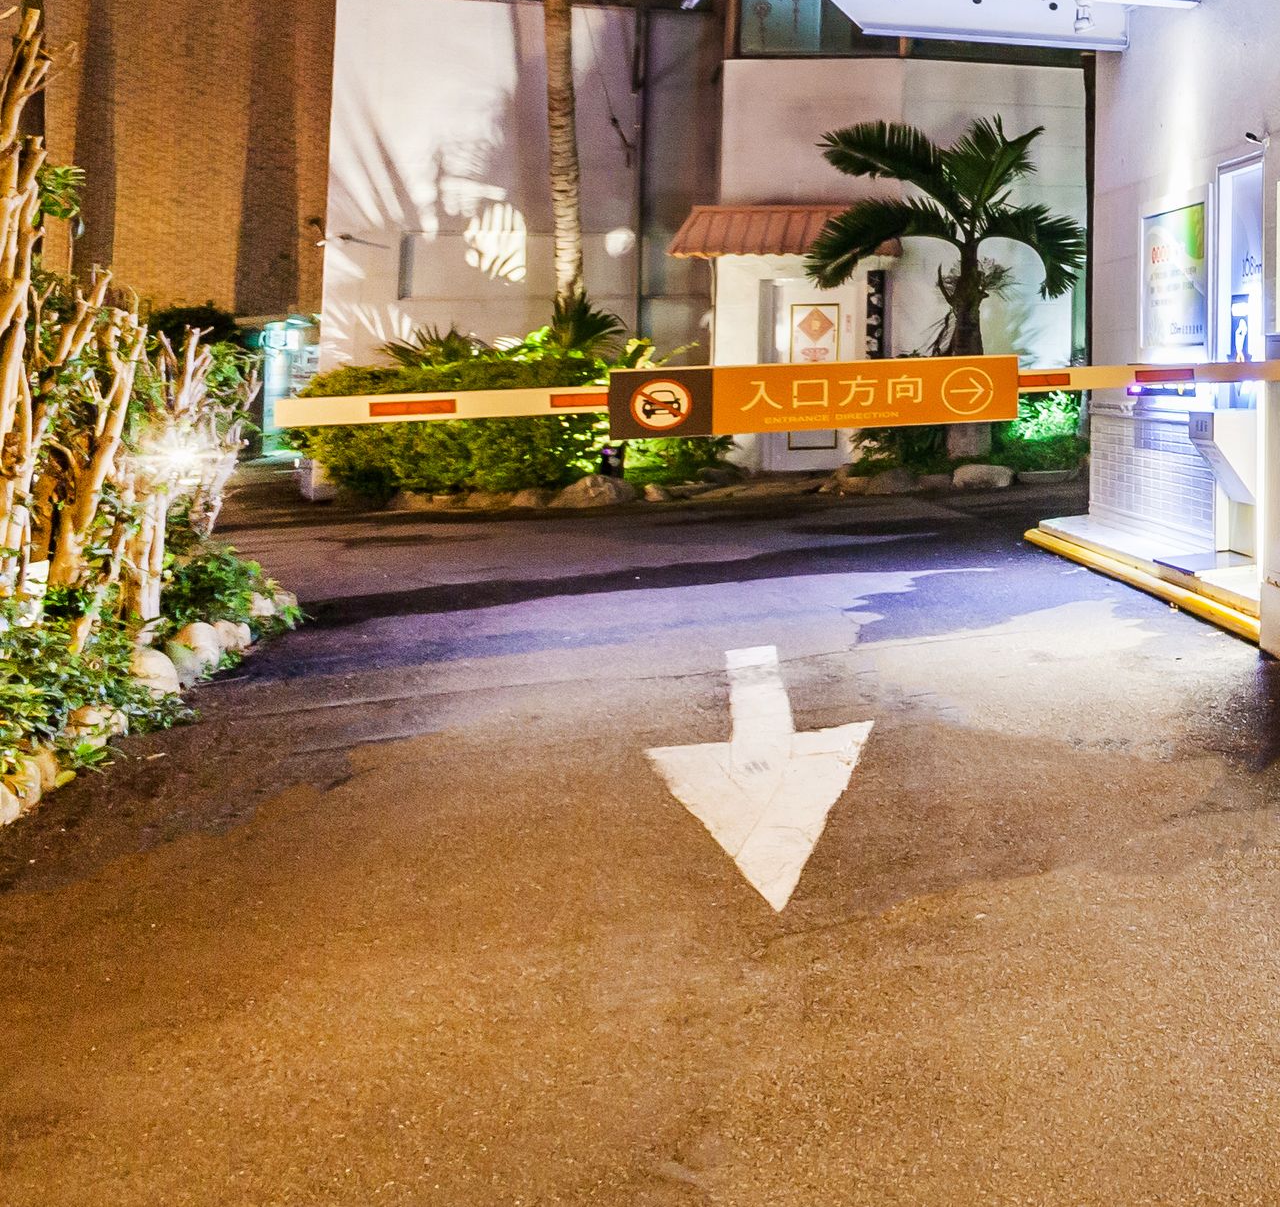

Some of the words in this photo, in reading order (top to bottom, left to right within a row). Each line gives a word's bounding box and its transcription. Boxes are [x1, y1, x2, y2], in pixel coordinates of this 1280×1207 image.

[740, 373, 923, 411] 入口方向
[764, 414, 830, 424] ENTRANCE
[835, 411, 899, 421] DIRECTION
